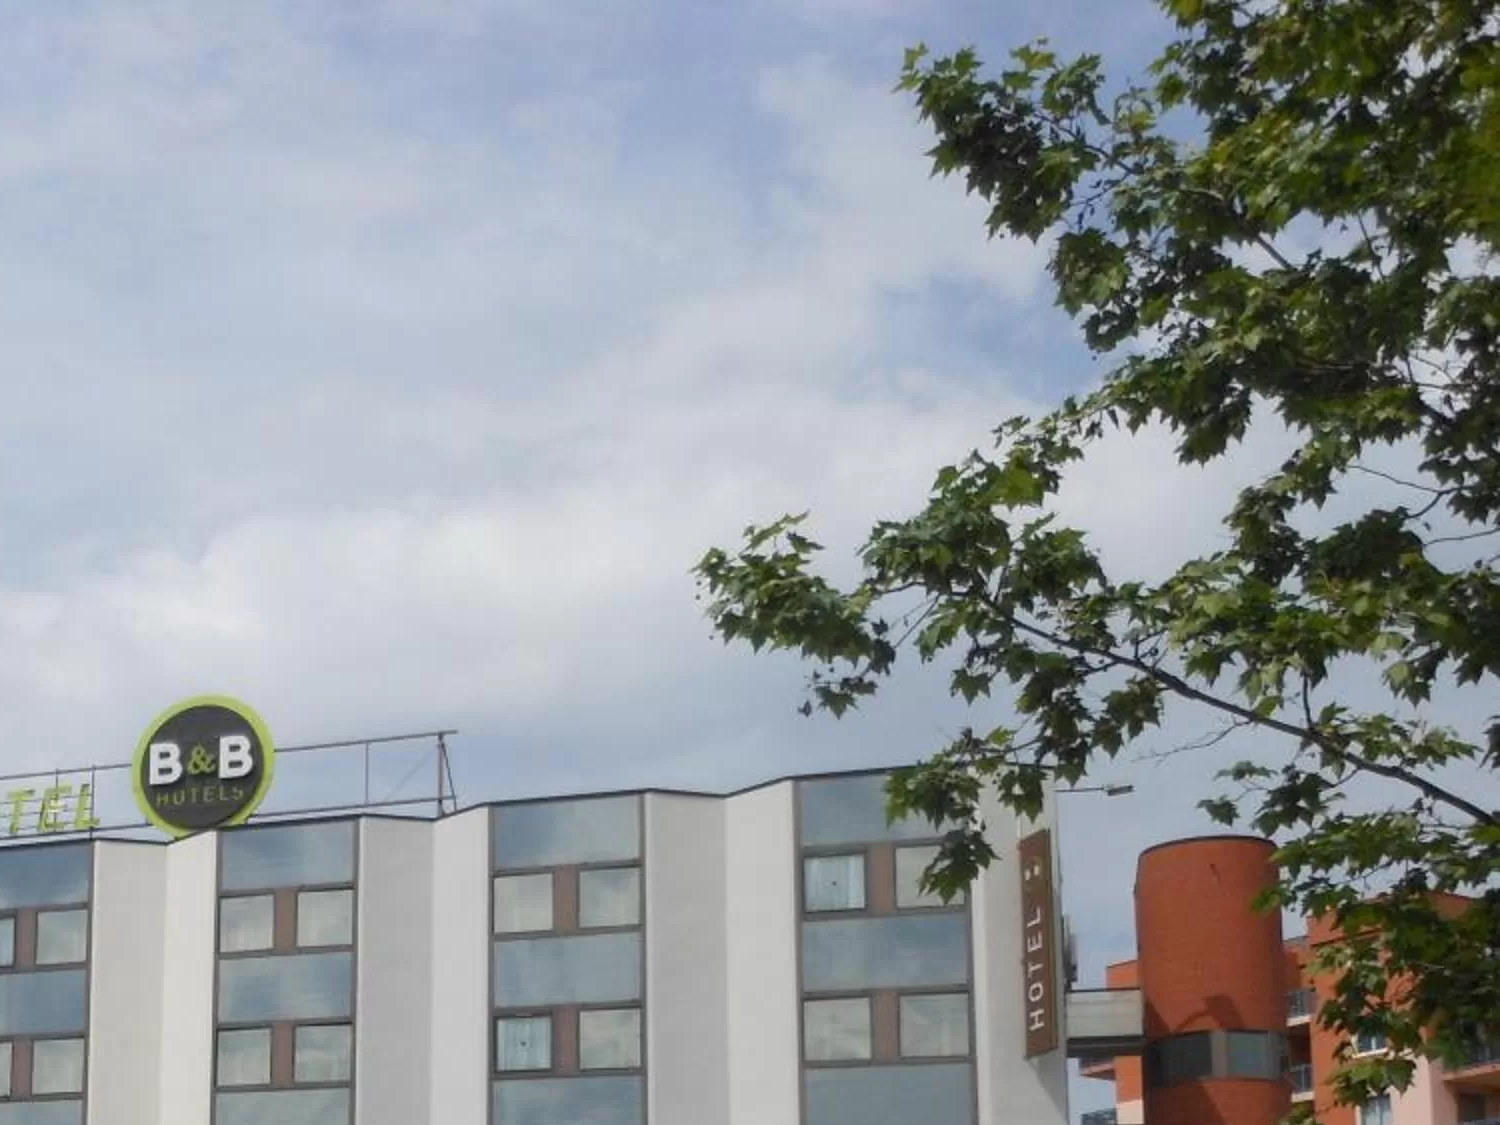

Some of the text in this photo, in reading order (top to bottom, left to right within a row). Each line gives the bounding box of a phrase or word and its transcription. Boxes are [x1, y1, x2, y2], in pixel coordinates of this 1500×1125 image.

[149, 735, 254, 785] B&B
[156, 785, 244, 808] HOTELS
[1026, 905, 1045, 1031] HOTEL
